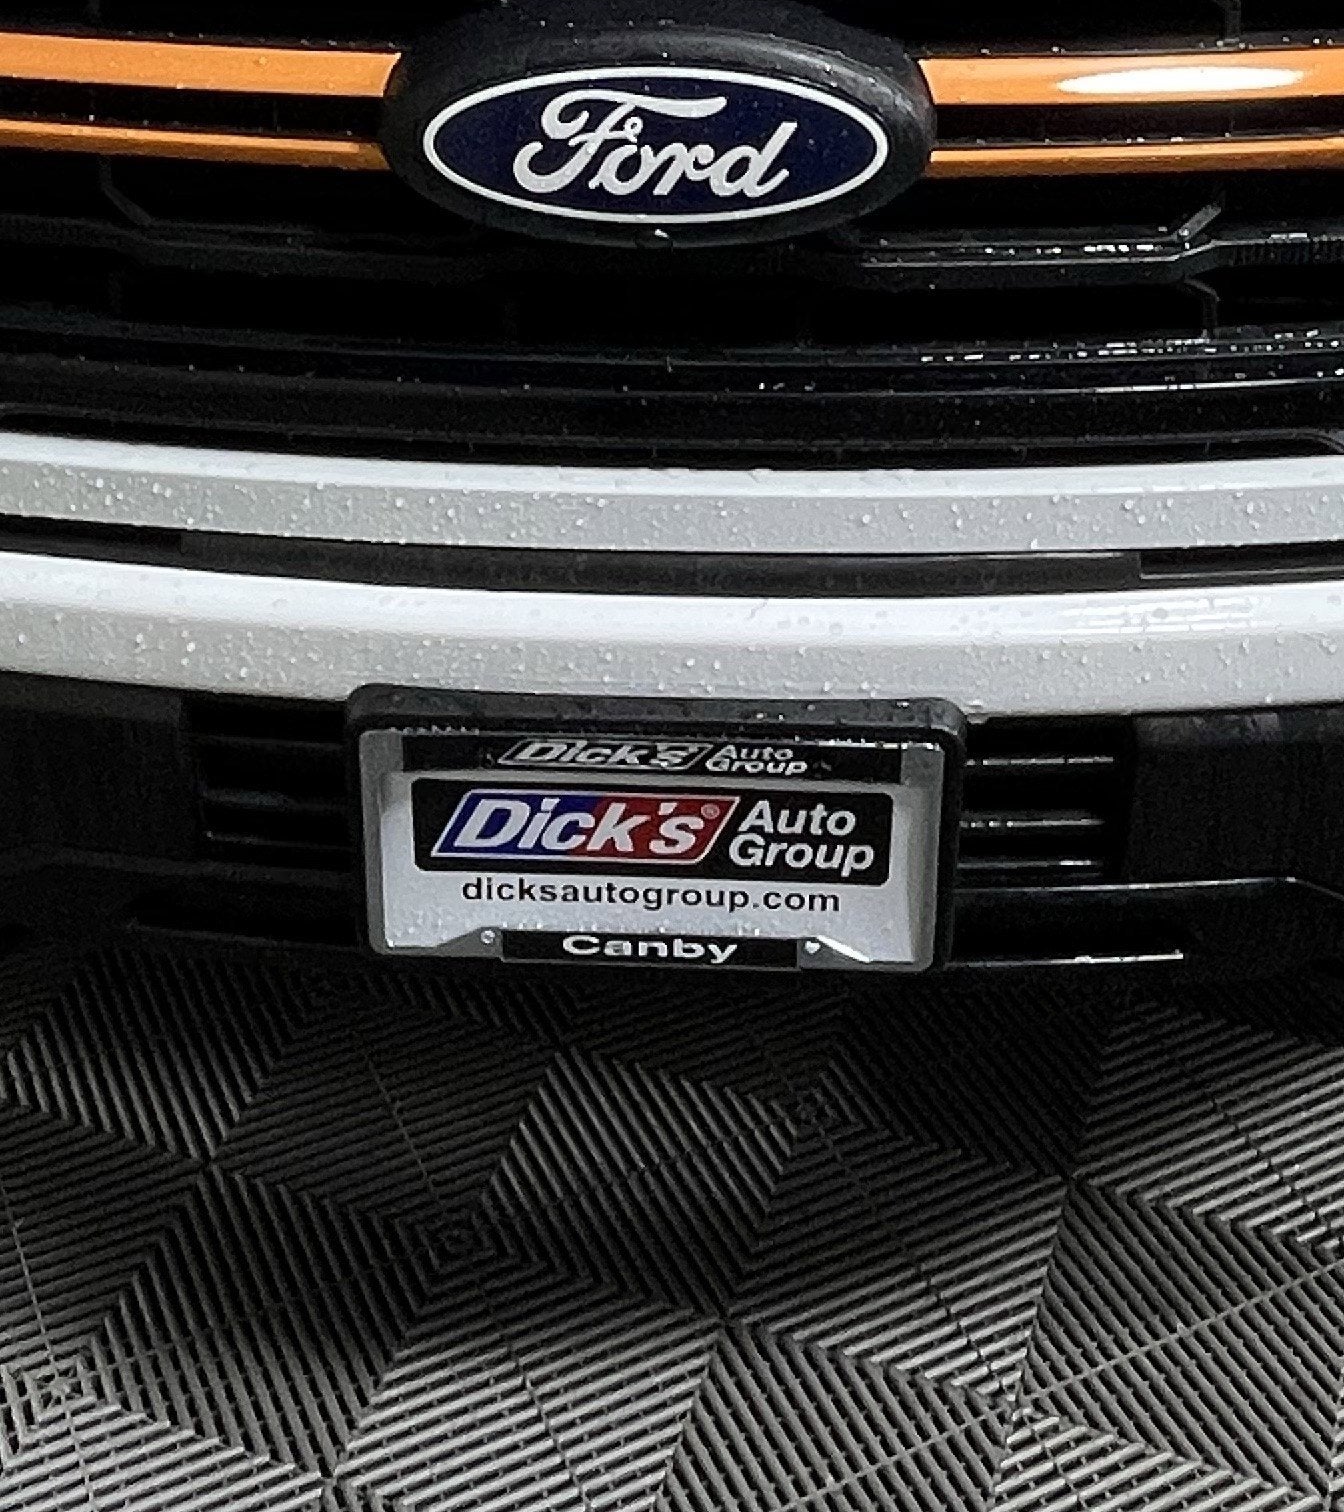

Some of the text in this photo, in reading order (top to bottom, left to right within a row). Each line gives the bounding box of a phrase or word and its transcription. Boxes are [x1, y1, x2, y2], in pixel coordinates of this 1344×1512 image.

[513, 89, 798, 196] Ford
[707, 758, 808, 775] Group
[712, 745, 794, 761] Auto
[455, 799, 705, 855] Dick's
[738, 800, 856, 836] Auto
[729, 835, 875, 877] Group
[462, 878, 840, 912] dicksautogroup.com
[562, 935, 738, 963] Canby
